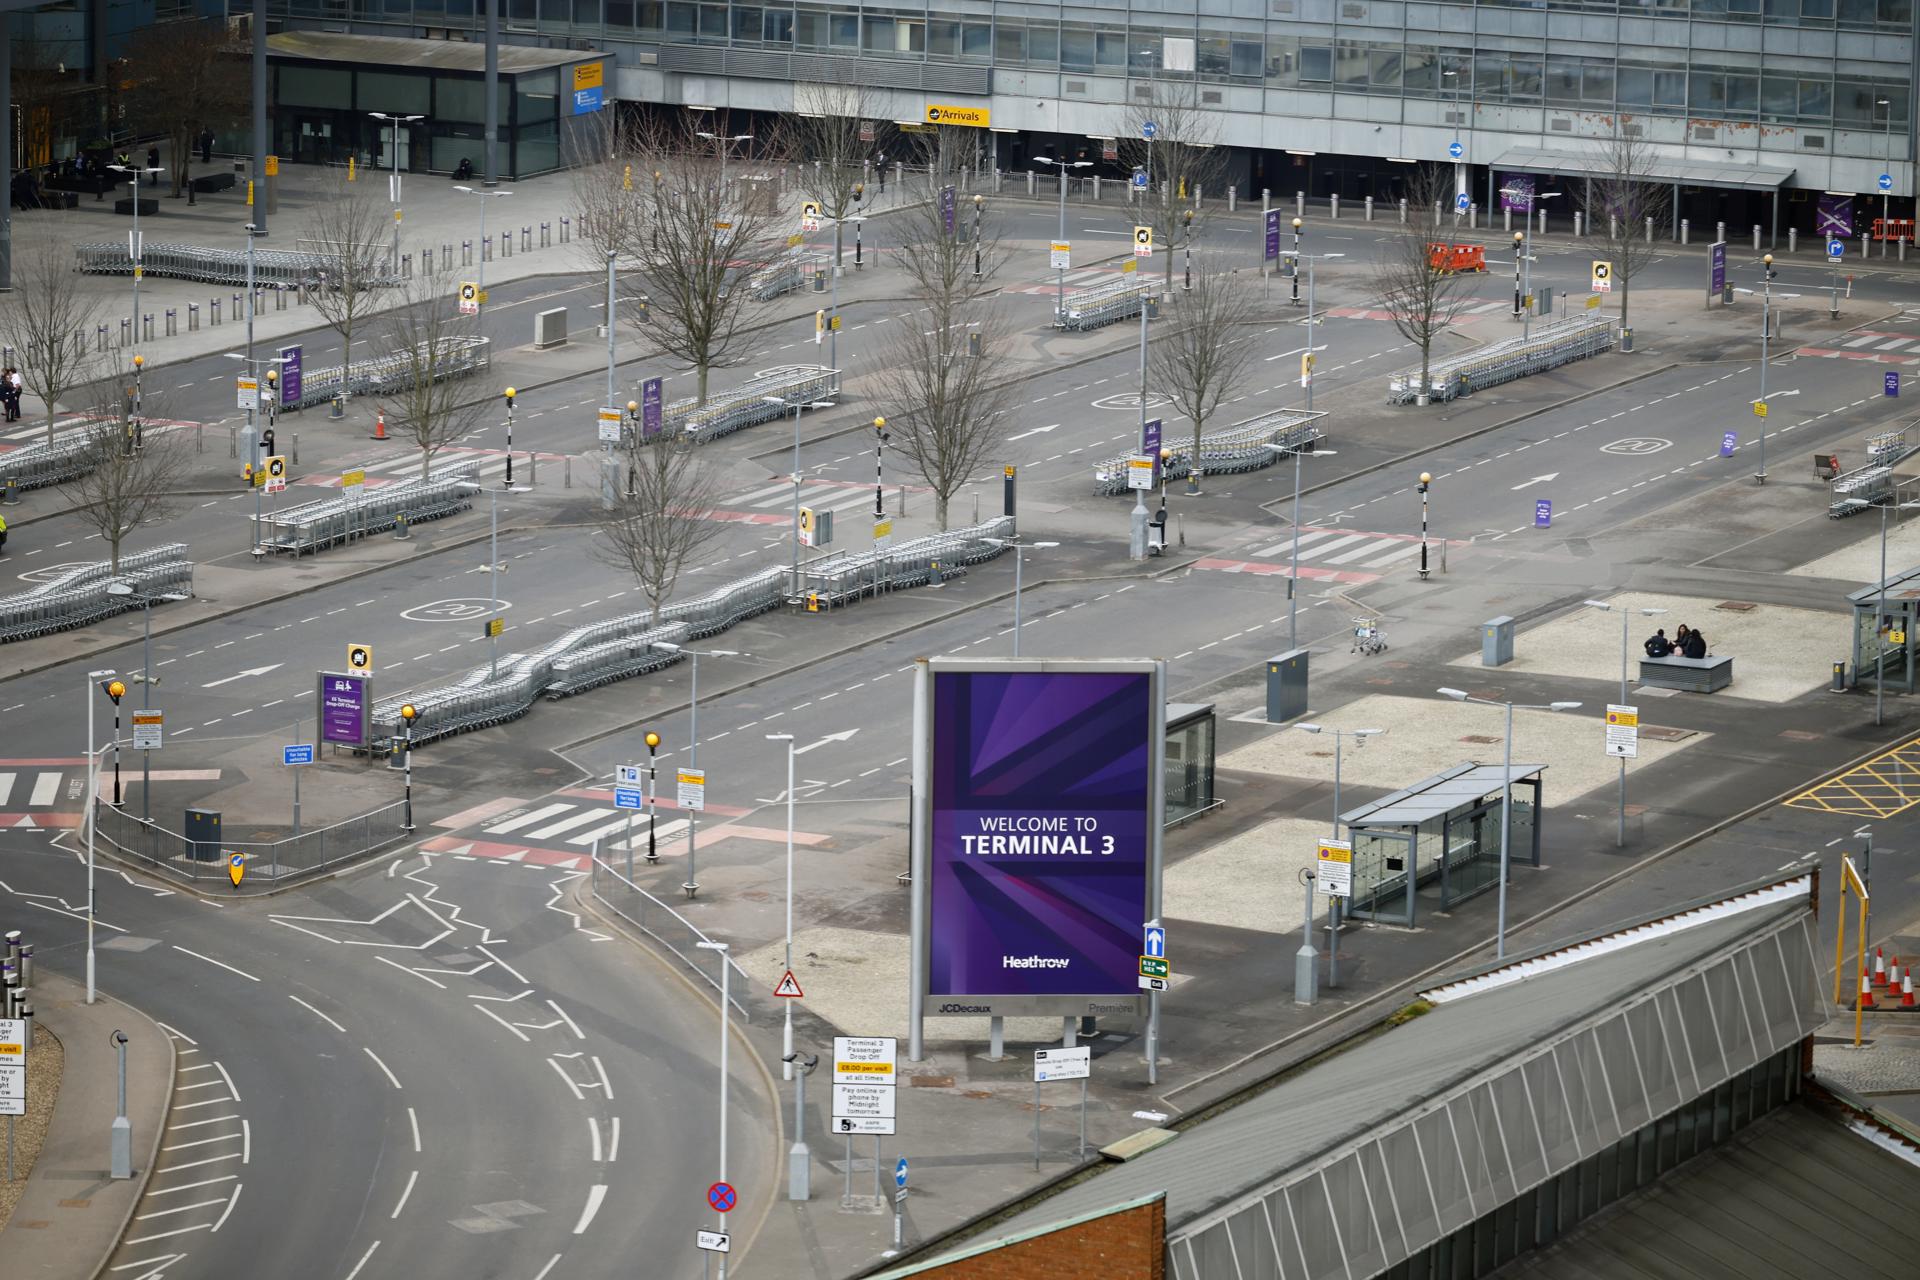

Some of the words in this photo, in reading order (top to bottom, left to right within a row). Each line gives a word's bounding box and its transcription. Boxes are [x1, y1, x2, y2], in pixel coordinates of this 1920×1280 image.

[942, 110, 980, 121] Arrivals
[1608, 440, 1662, 452] 20
[423, 603, 485, 616] 20
[979, 817, 1068, 832] WELCOME
[1074, 817, 1097, 832] TO
[961, 835, 1093, 855] TERMINAL
[1101, 835, 1115, 855] 3
[1002, 955, 1069, 968] Heathrow
[939, 1003, 991, 1013] JCDecaux
[1089, 1003, 1134, 1013] Première
